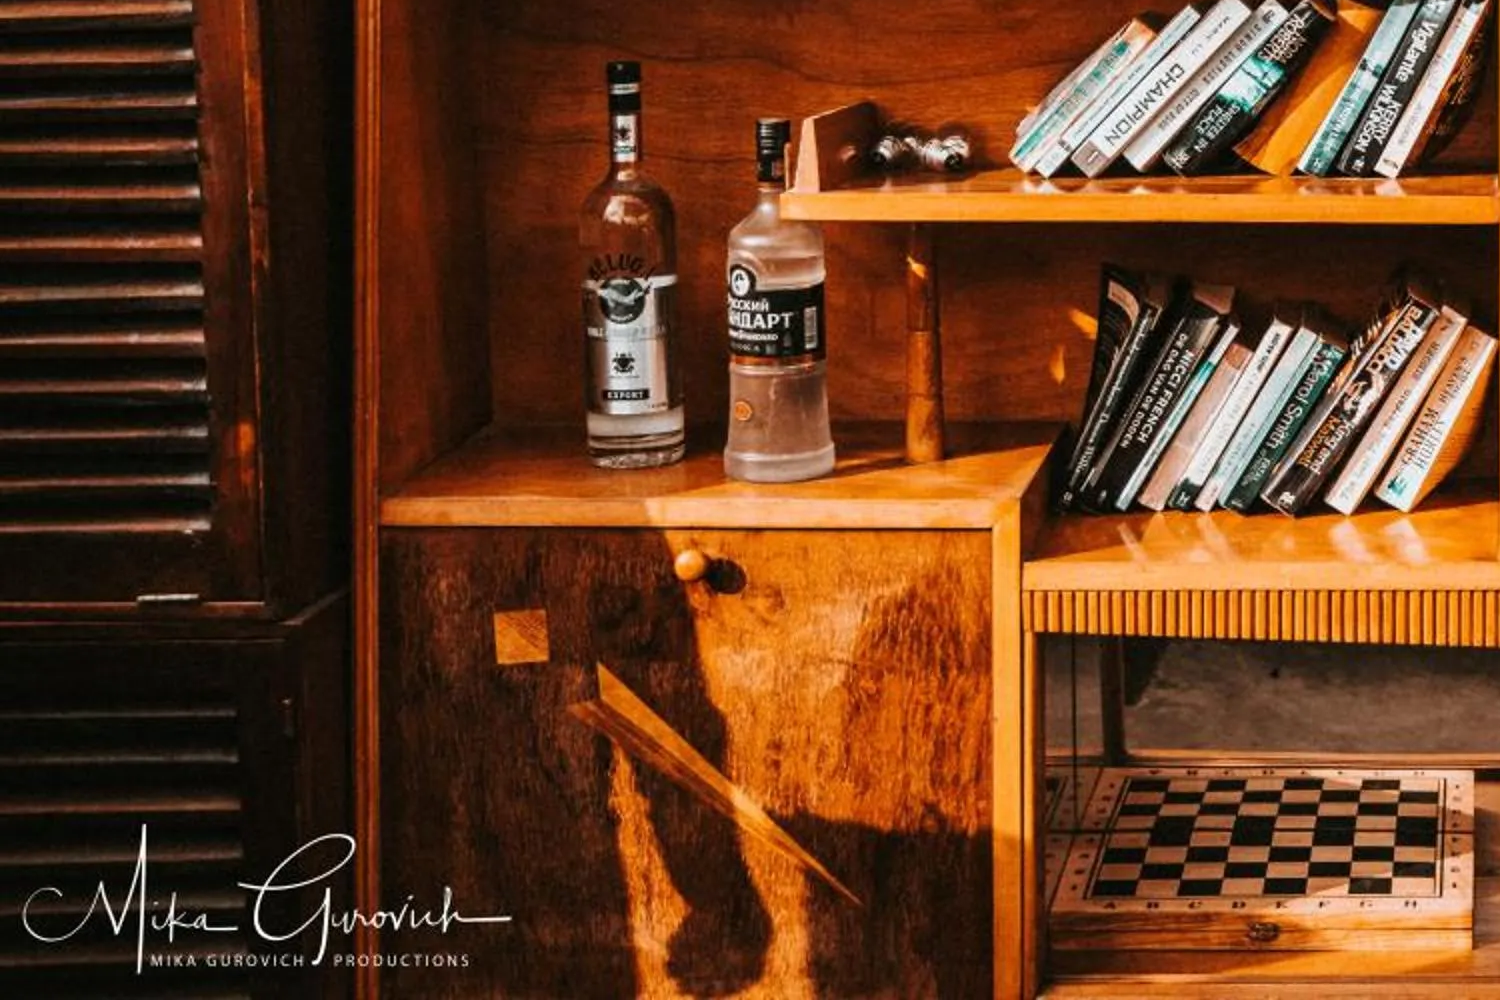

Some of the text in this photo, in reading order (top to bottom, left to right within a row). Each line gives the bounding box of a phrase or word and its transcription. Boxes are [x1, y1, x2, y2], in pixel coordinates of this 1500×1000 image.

[1257, 12, 1305, 66] ROBERTS
[1391, 15, 1439, 86] Vigilante
[1103, 60, 1186, 148] CHAMPION
[1203, 100, 1240, 141] SHELTER
[1353, 80, 1398, 153] WILKINSON
[1370, 98, 1402, 145] KERRY
[1193, 137, 1209, 153] IN
[1365, 302, 1422, 378] BALDACCI
[1384, 322, 1424, 372] DAVID
[607, 389, 645, 400] EXPORT
[1119, 331, 1188, 450] DE DAG VAN DE DODEN
[1292, 358, 1330, 405] Carol
[1136, 386, 1173, 445] FRENCH
[1264, 401, 1303, 451] Smith
[1296, 413, 1339, 469] Maxwell
[1397, 406, 1440, 467] GRAHAM
[1308, 418, 1355, 476] King and
